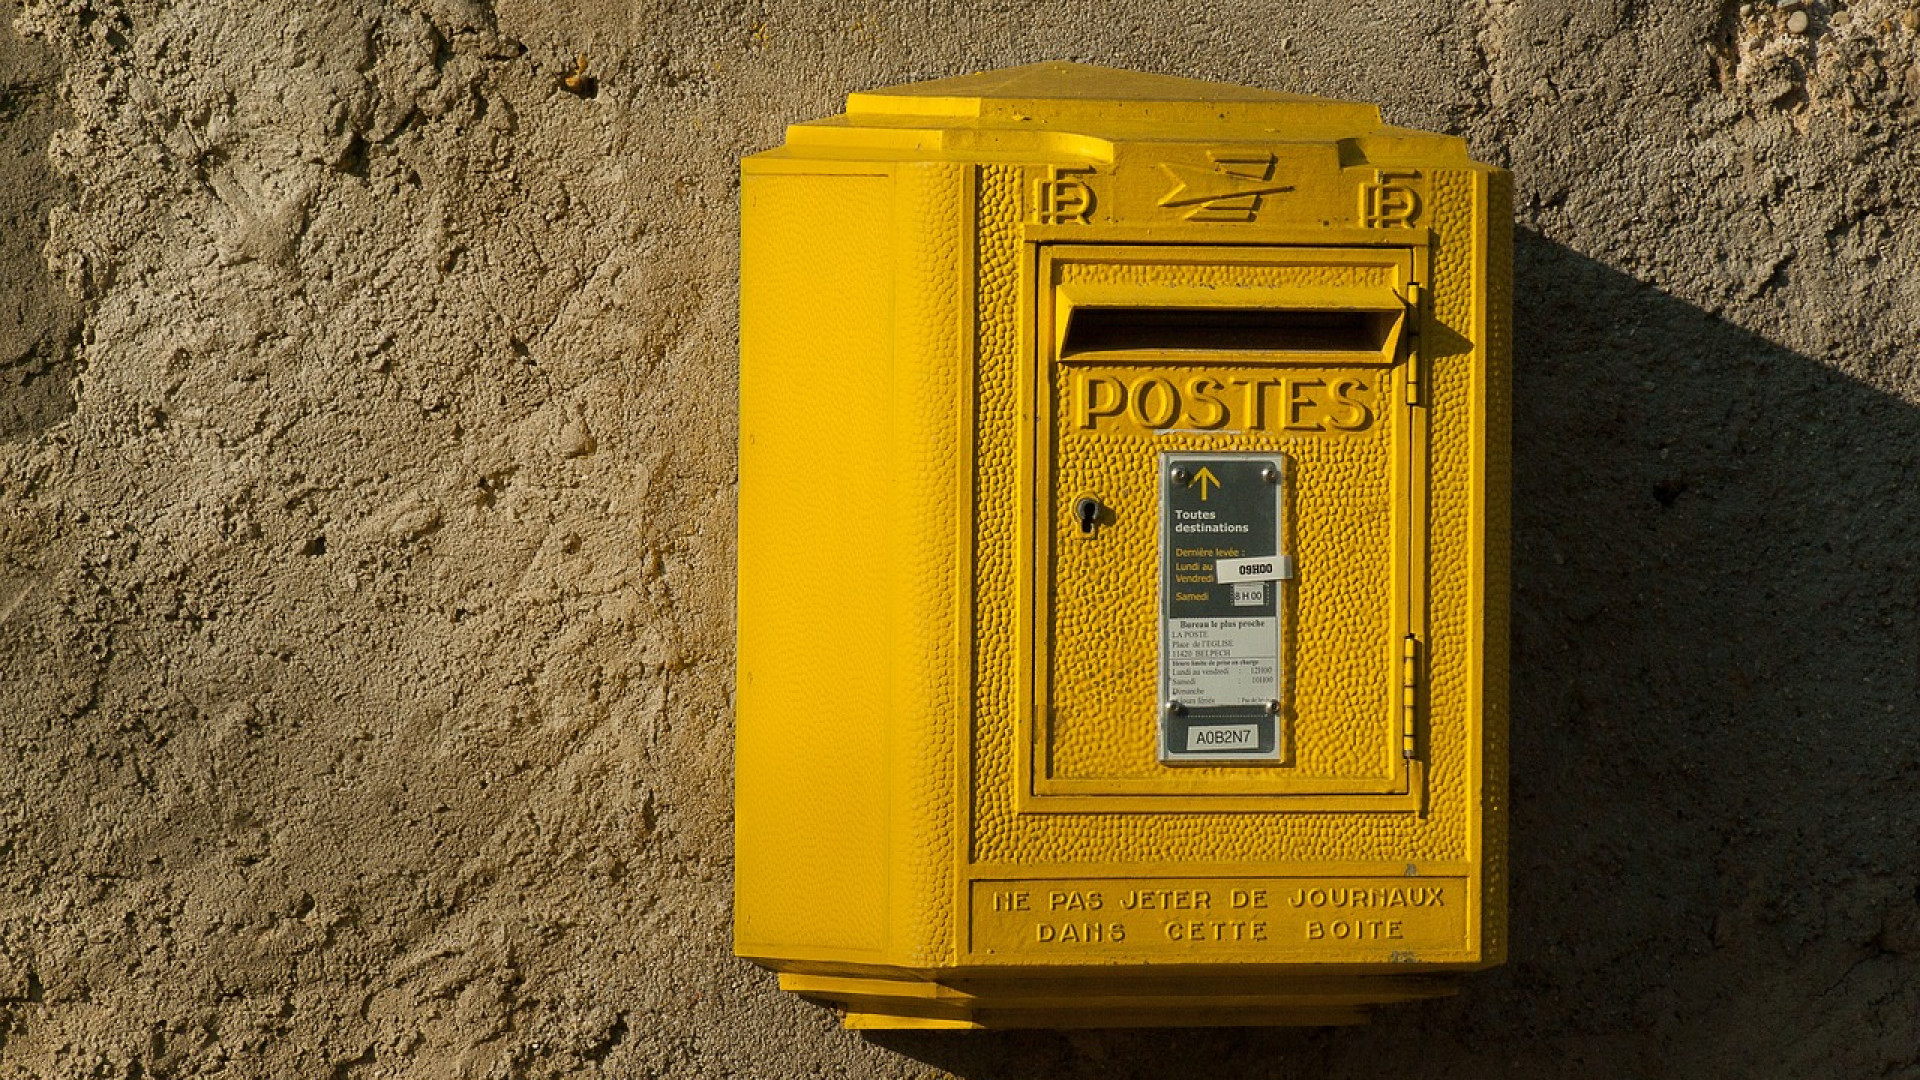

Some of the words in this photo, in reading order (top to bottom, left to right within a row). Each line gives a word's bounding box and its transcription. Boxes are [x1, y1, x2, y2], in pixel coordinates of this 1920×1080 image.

[1077, 376, 1374, 432] POSTES
[1175, 509, 1216, 520] Toutes
[1175, 522, 1249, 533] destinations
[1176, 547, 1213, 557] Dernière
[1176, 562, 1200, 571] Lundi
[1238, 563, 1273, 575] 09H00
[1176, 574, 1214, 583] Vendredi
[1176, 592, 1209, 601] Samedi
[1180, 620, 1209, 628] Bureau
[1210, 620, 1218, 628] le
[1220, 620, 1236, 630] plus
[1238, 620, 1265, 629] proche
[1195, 729, 1251, 744] A0B2N7
[991, 891, 1031, 912] NE
[1048, 891, 1103, 911] PAS
[1119, 890, 1211, 911] JETER
[1230, 889, 1268, 909] DE
[1286, 887, 1445, 908] JOURNAUX
[1036, 923, 1126, 943] DANS
[1163, 921, 1268, 942] CETTE
[1304, 920, 1405, 940] BOITE
